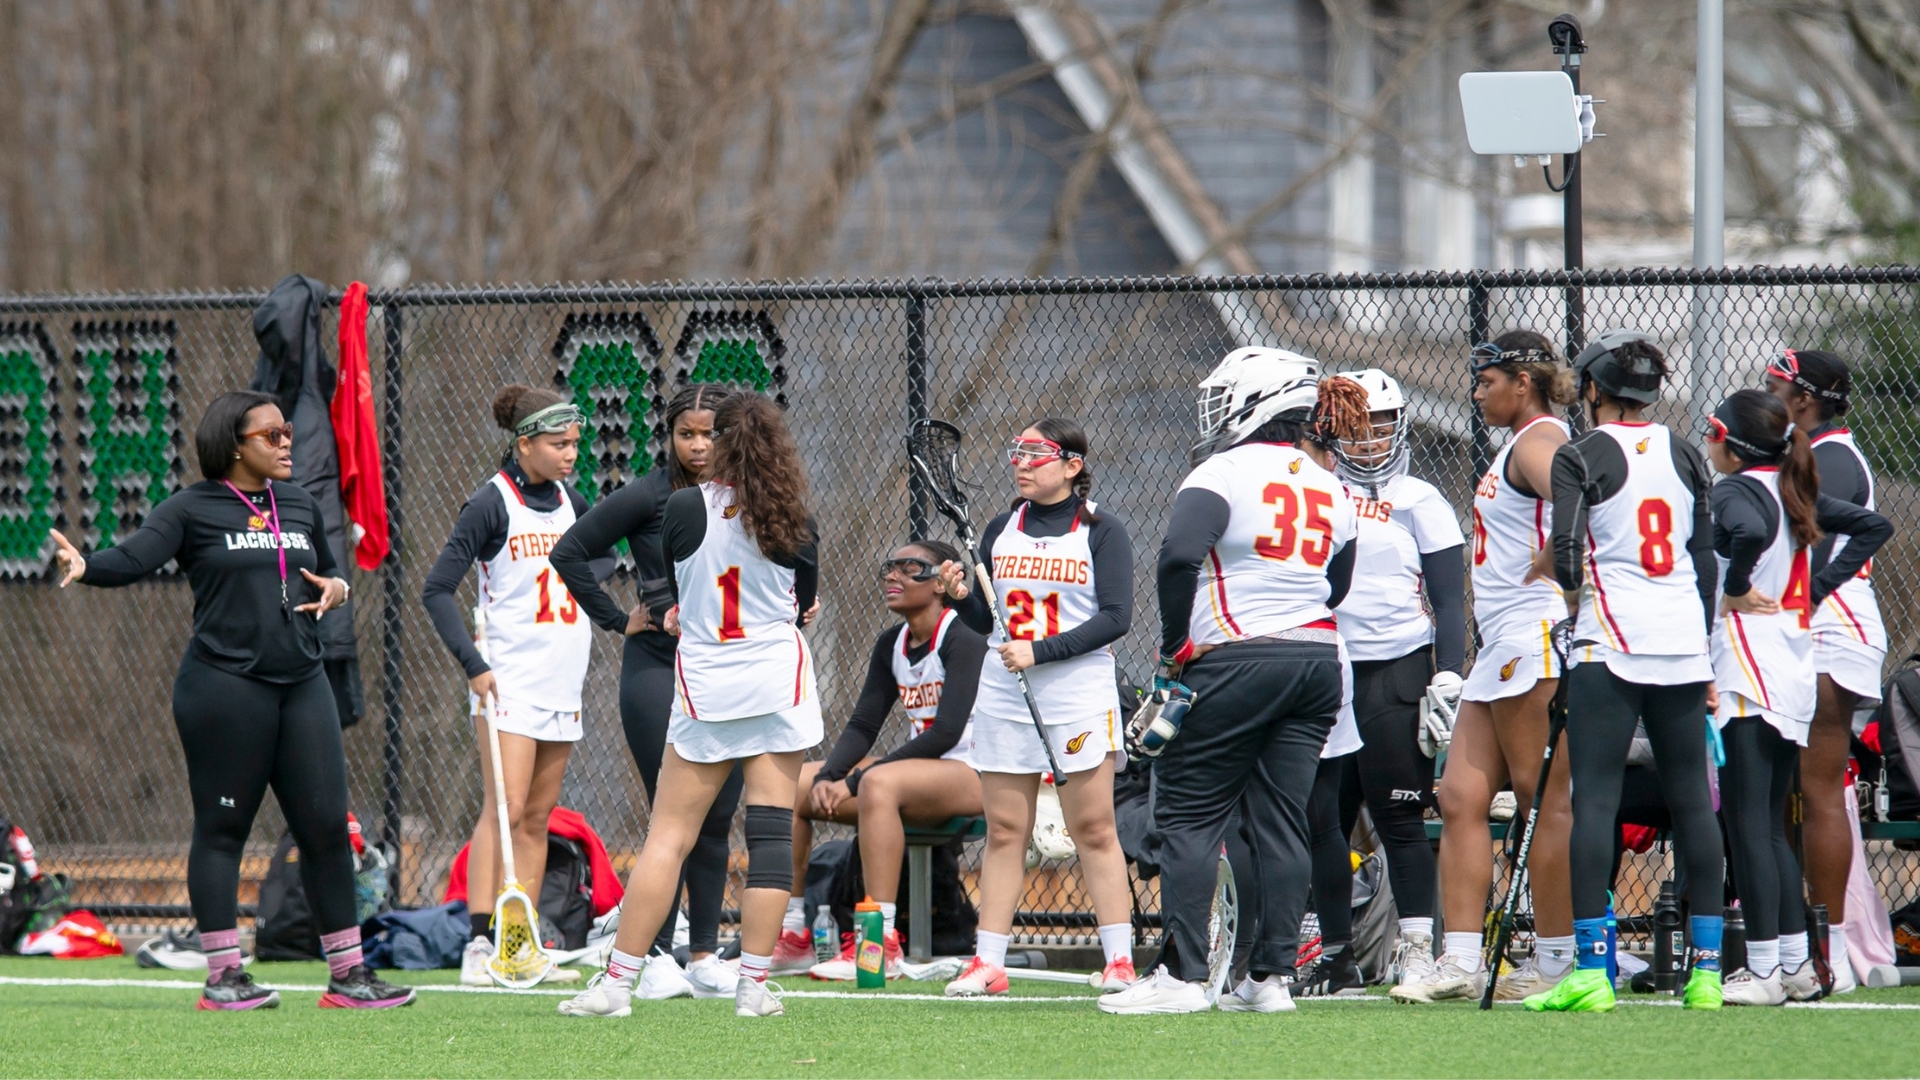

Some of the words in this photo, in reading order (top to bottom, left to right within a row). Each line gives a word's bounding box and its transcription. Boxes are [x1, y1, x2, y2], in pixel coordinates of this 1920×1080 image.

[224, 532, 310, 550] LACROSSE
[1253, 482, 1335, 569] 35
[1637, 497, 1674, 578] 8
[993, 555, 1089, 585] FIREBIRDS
[717, 565, 747, 643] 1
[1005, 588, 1061, 641] 21
[1390, 789, 1422, 801] STX
[1504, 868, 1521, 915] UNDER
[1517, 808, 1538, 868] ARMOUR
